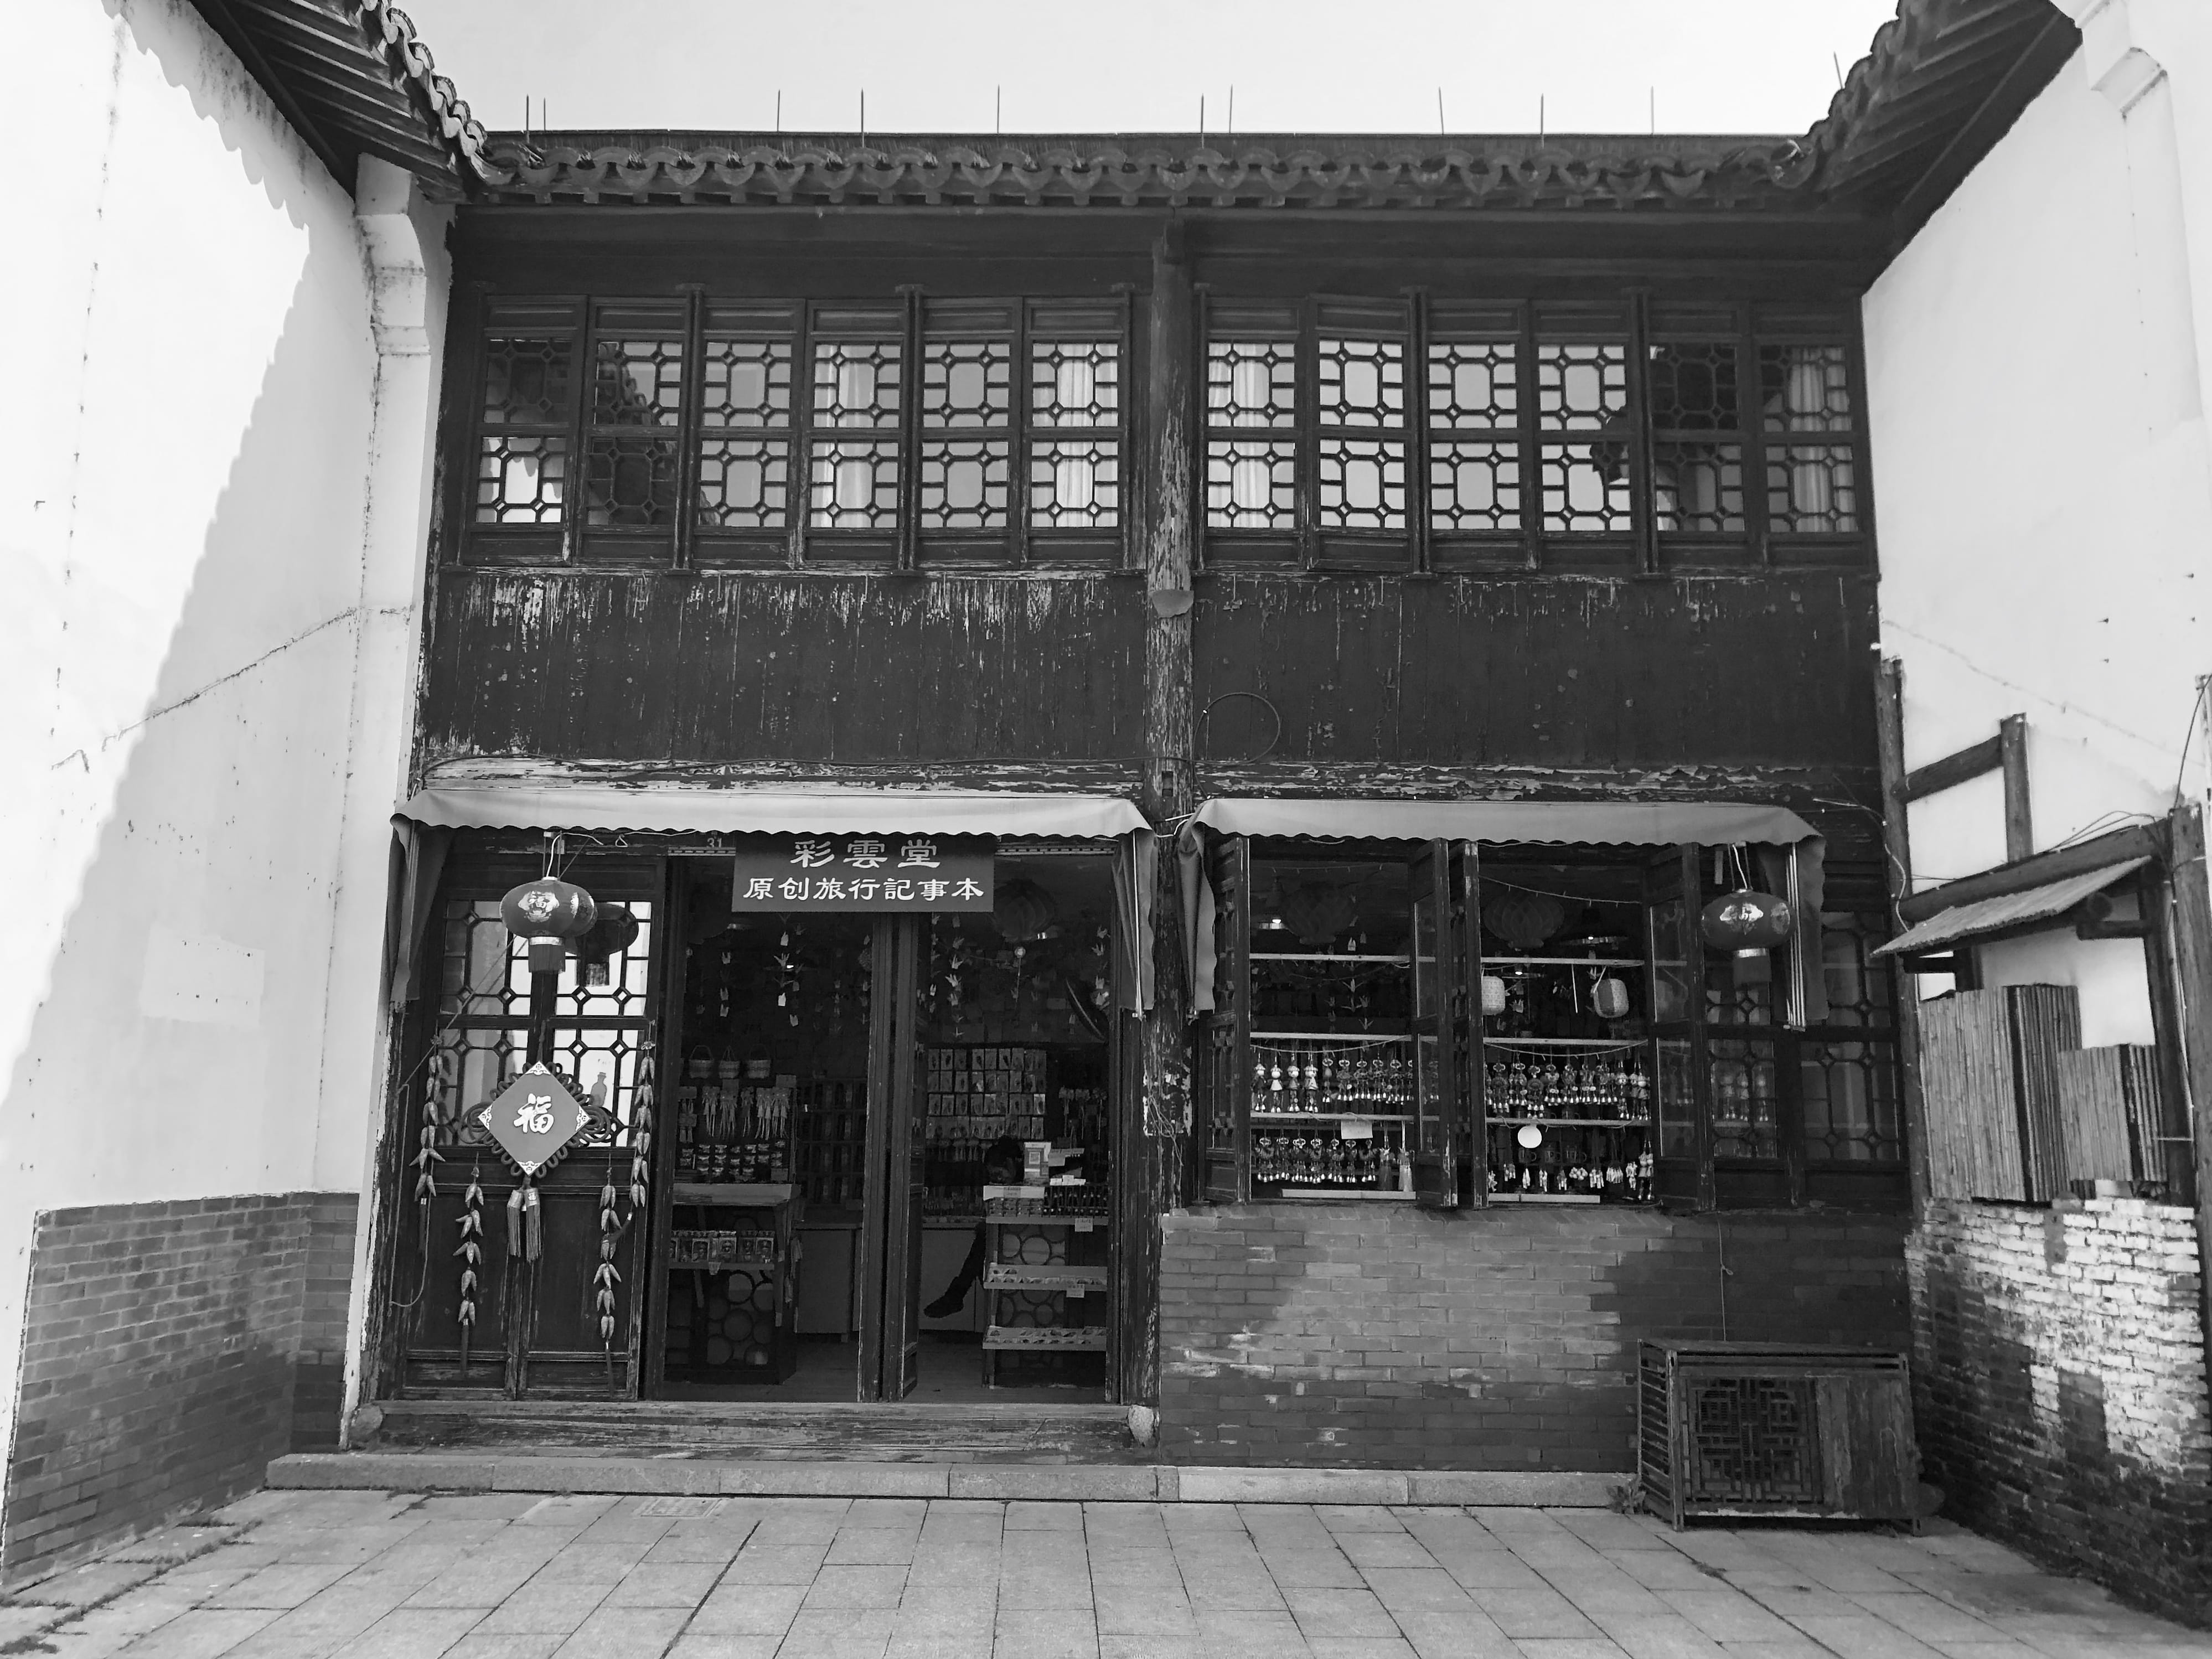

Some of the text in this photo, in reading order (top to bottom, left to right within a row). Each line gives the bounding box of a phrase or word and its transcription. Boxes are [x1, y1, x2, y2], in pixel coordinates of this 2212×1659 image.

[790, 839, 941, 869] 彩雲堂
[743, 877, 984, 901] 原创旅行記事本
[513, 1092, 555, 1134] 福
